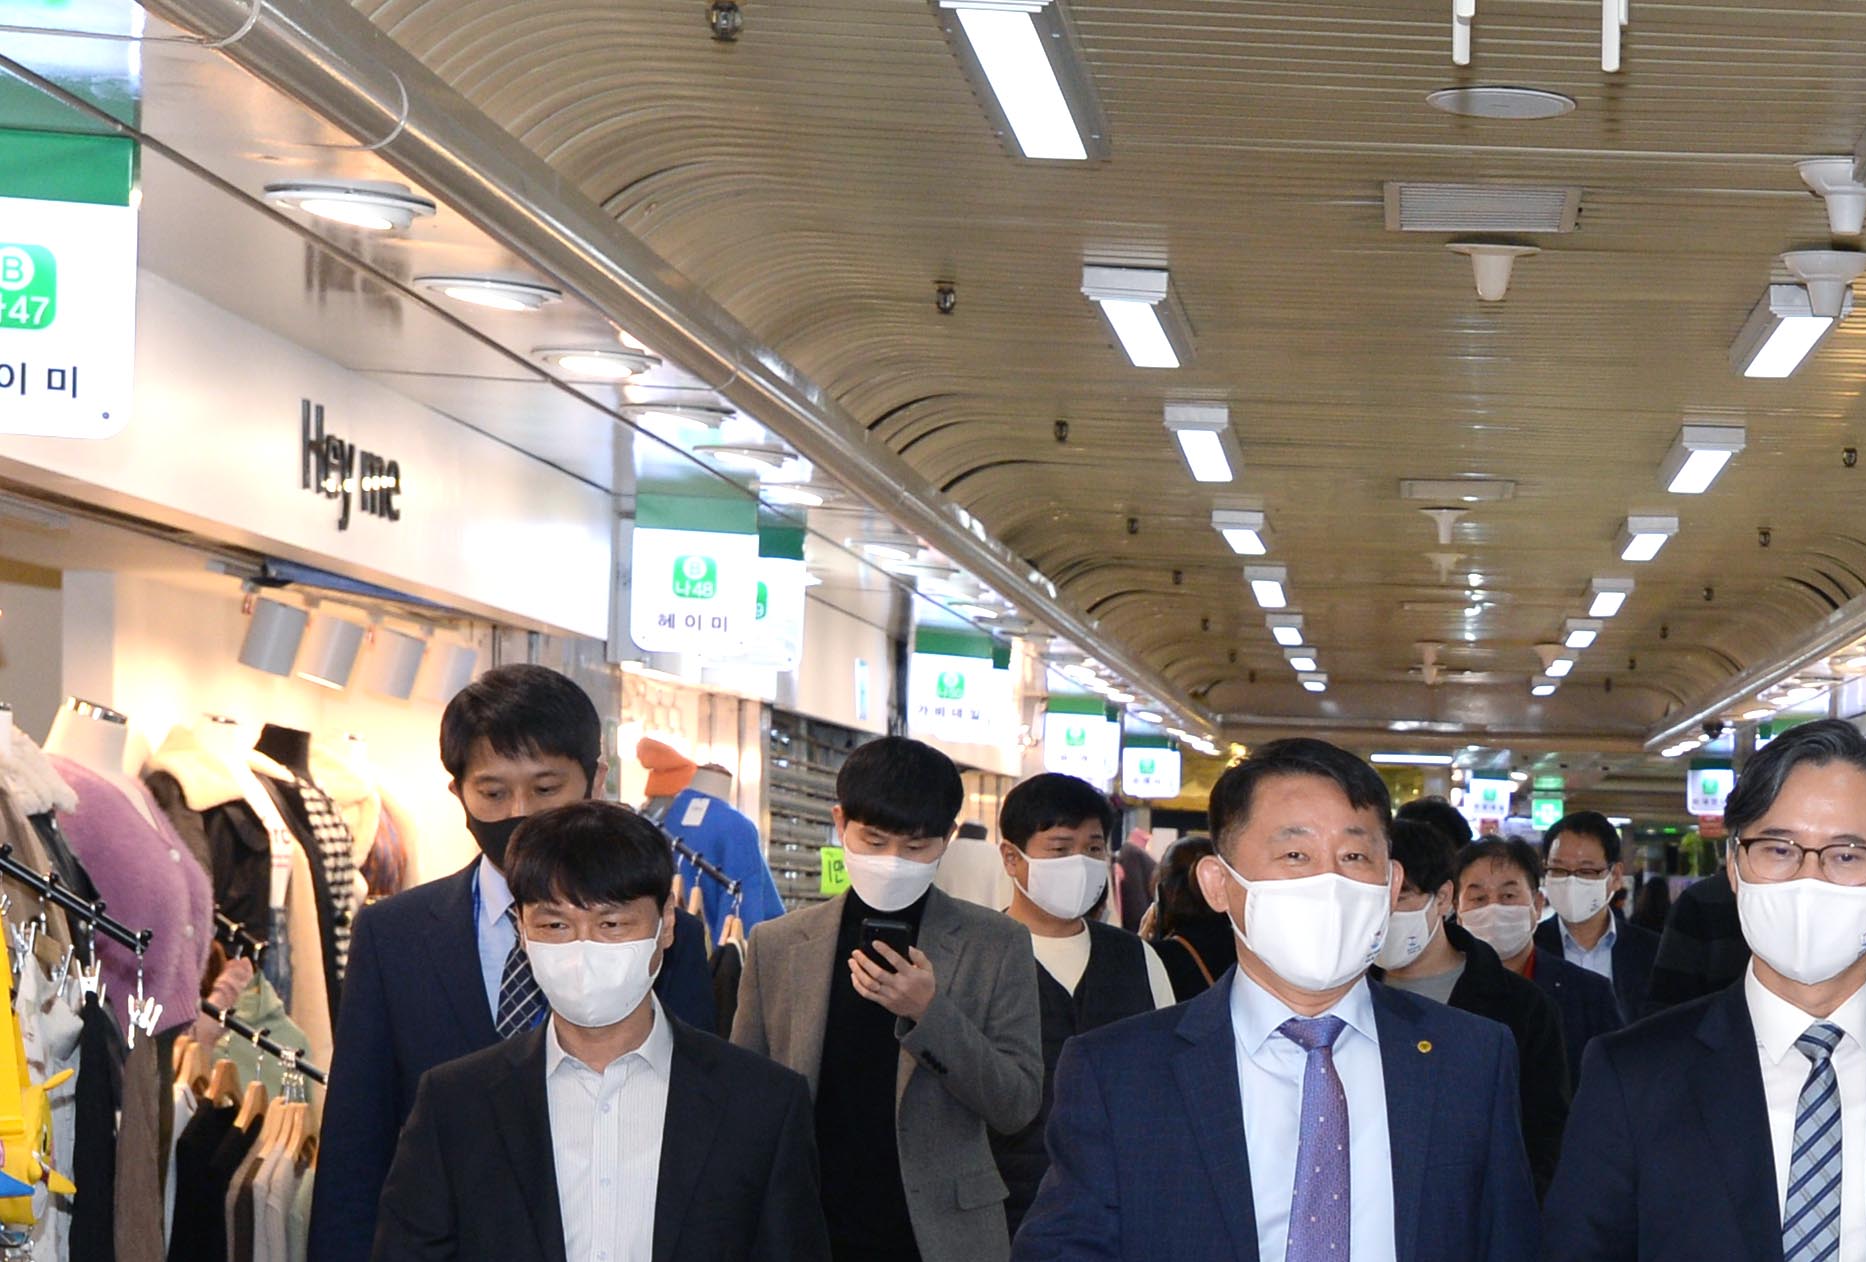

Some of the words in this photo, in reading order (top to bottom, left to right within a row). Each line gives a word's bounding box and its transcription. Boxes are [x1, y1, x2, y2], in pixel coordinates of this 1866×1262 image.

[301, 399, 355, 532] Hey
[359, 450, 401, 522] me
[657, 612, 729, 633] 헤이미
